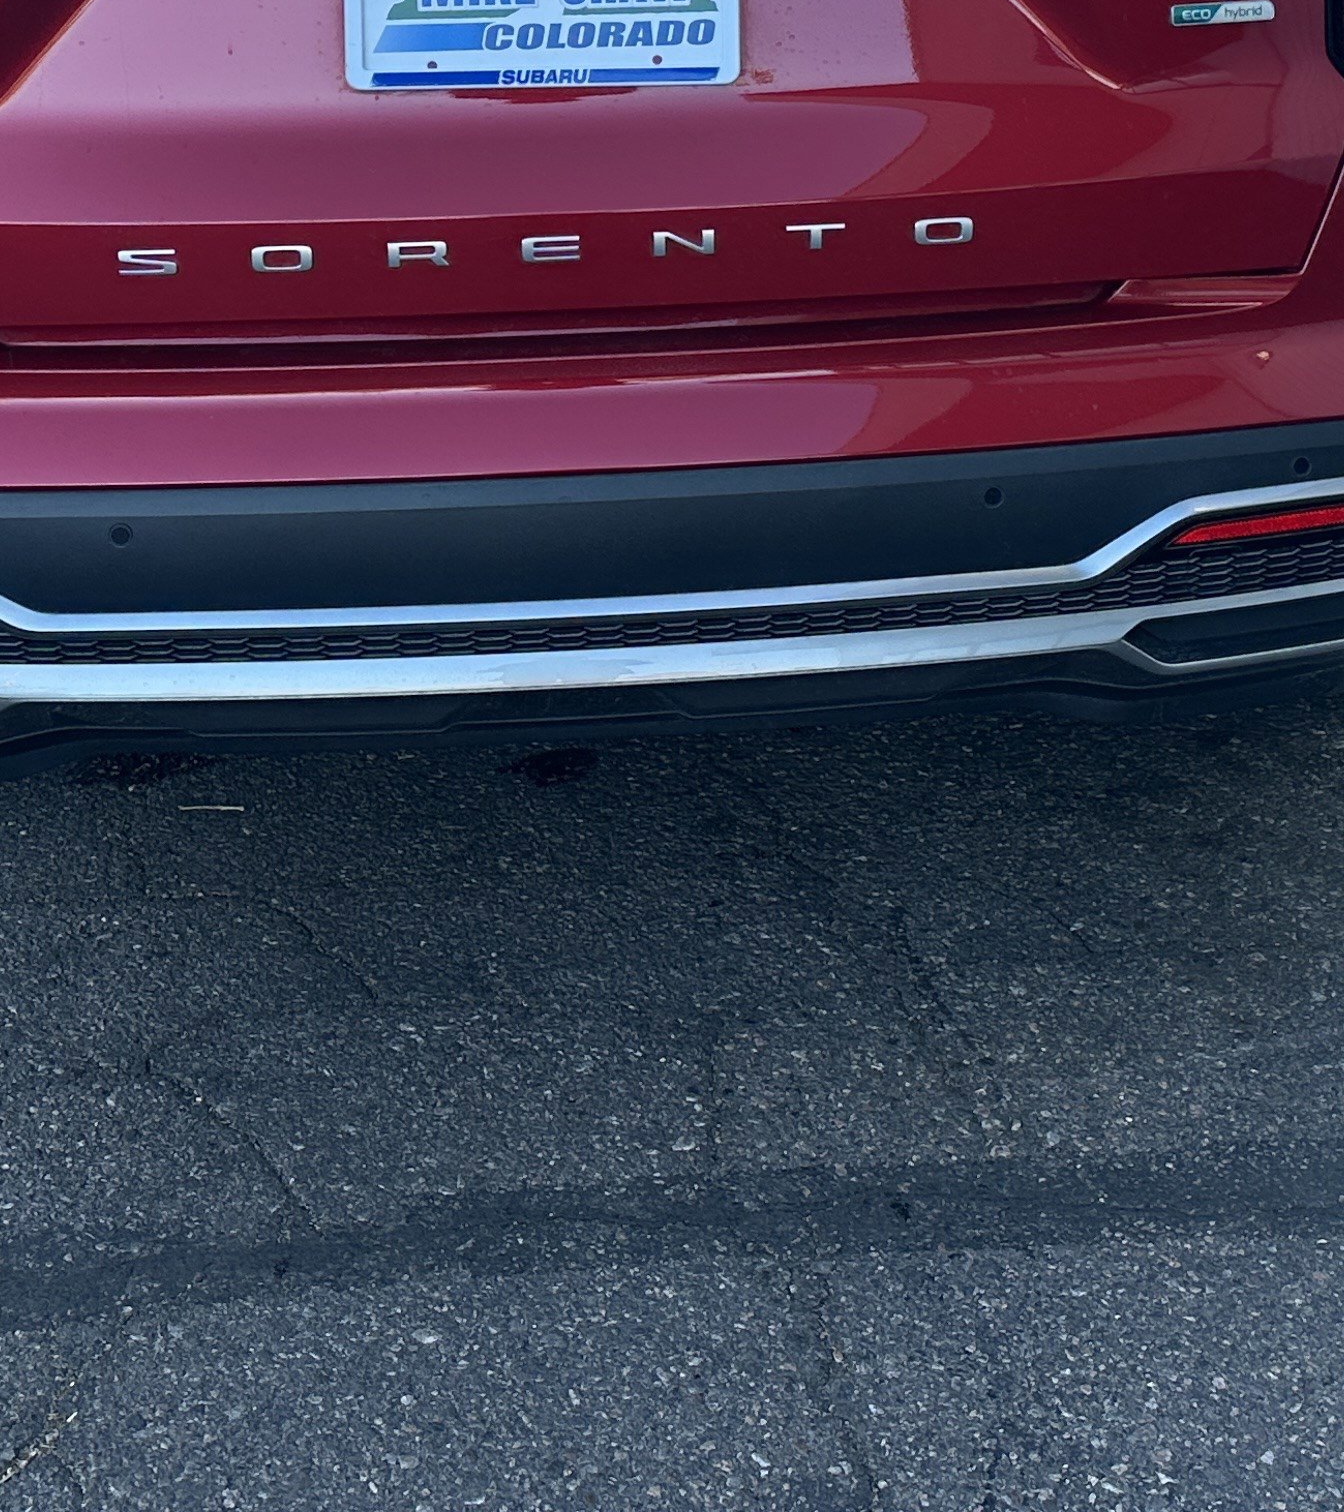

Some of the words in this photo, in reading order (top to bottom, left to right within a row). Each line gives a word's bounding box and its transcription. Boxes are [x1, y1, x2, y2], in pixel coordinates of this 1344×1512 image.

[1223, 4, 1263, 20] hybrid
[484, 18, 716, 51] COLORADO
[500, 69, 589, 85] SUBARU
[116, 214, 975, 277] SORENTO
